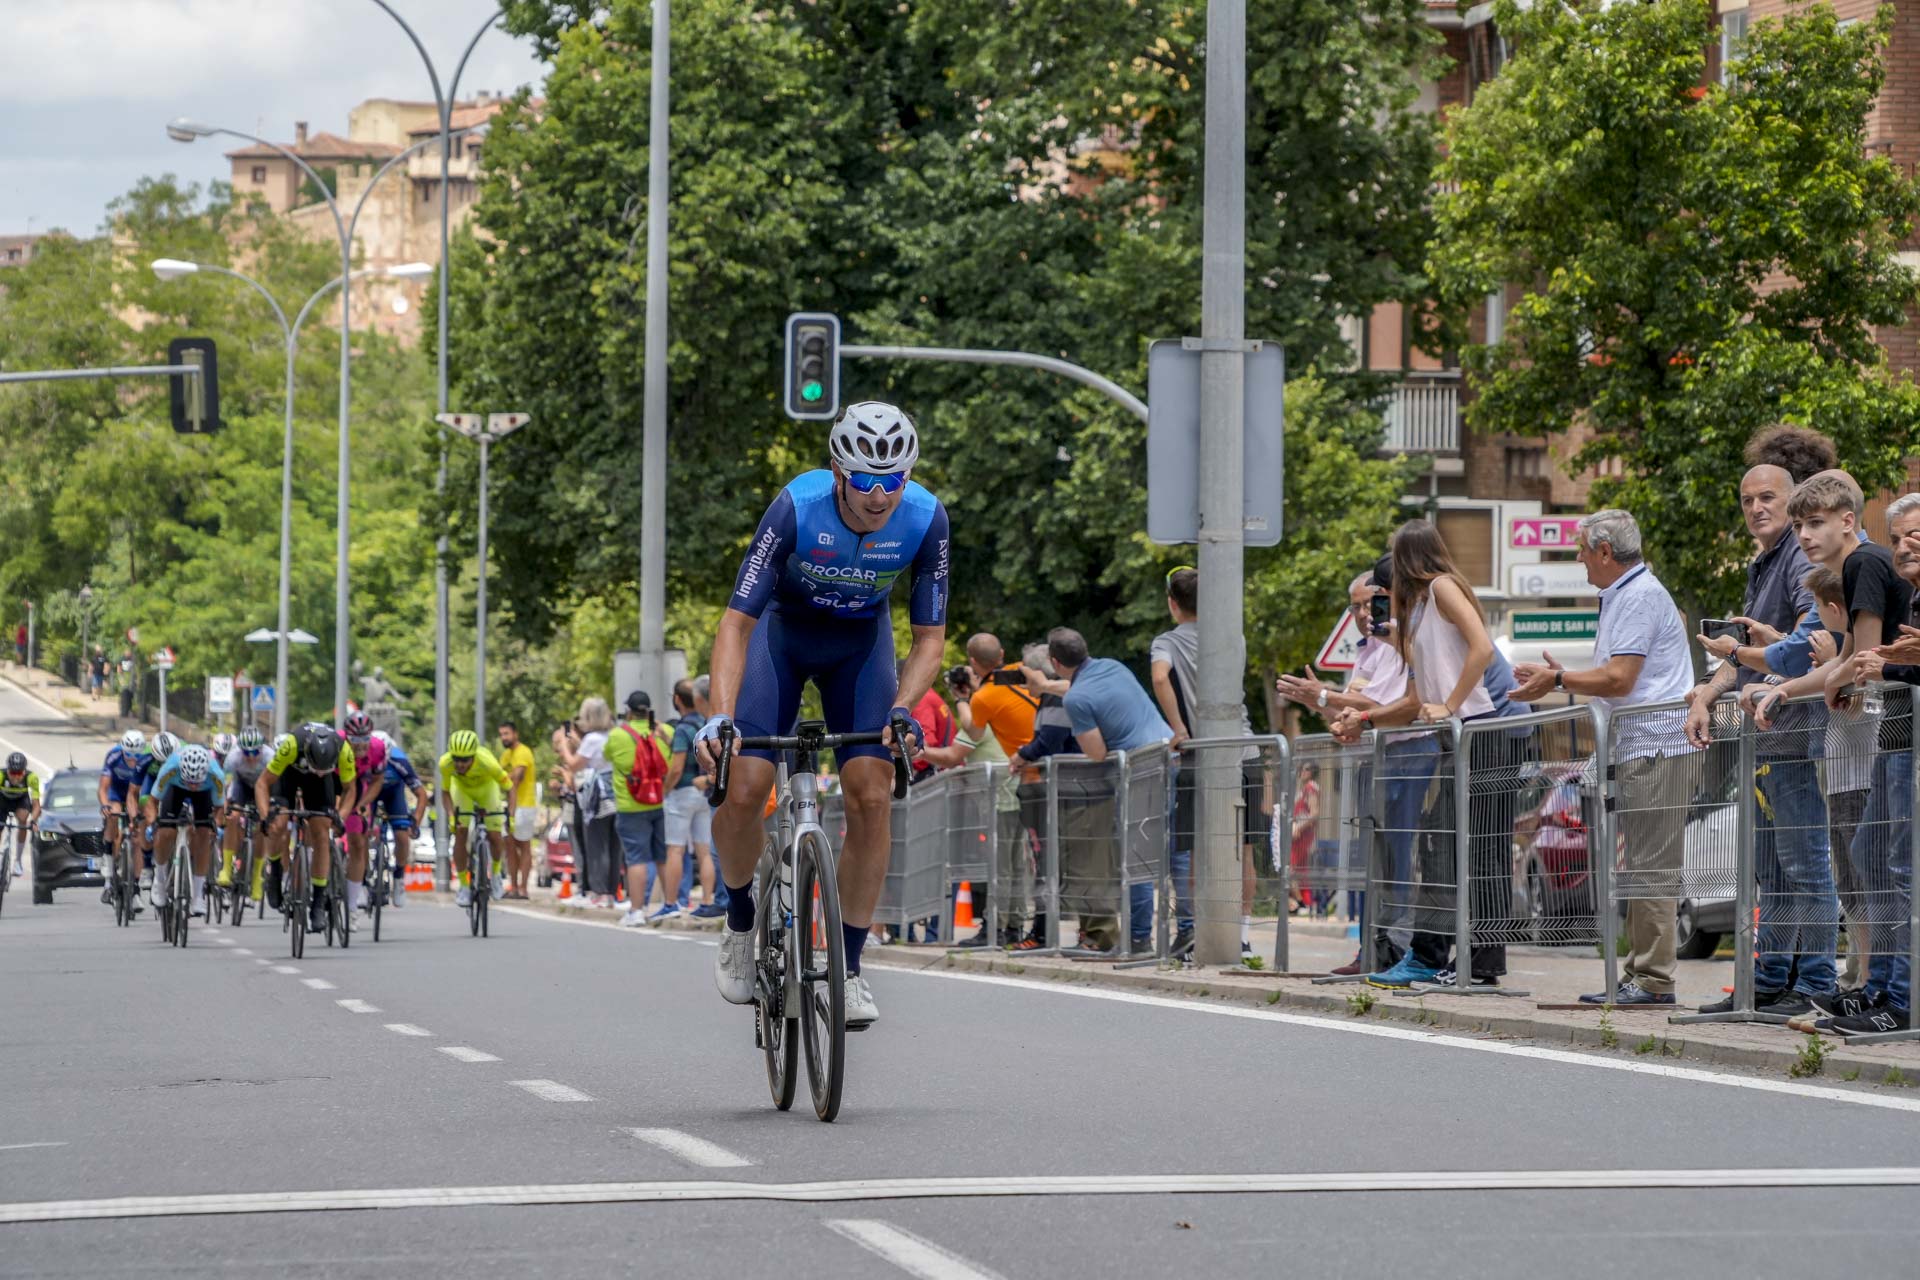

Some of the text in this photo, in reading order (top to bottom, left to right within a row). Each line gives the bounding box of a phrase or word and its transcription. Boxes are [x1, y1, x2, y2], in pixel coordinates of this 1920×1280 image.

[736, 526, 776, 598] impriDekor
[800, 560, 877, 582] BROCAR
[1515, 622, 1549, 632] BARRIO
[1550, 622, 1563, 632] DE
[1564, 621, 1584, 632] SAN
[797, 801, 816, 809] BH
[1843, 998, 1862, 1016] N
[1870, 1012, 1898, 1031] N
